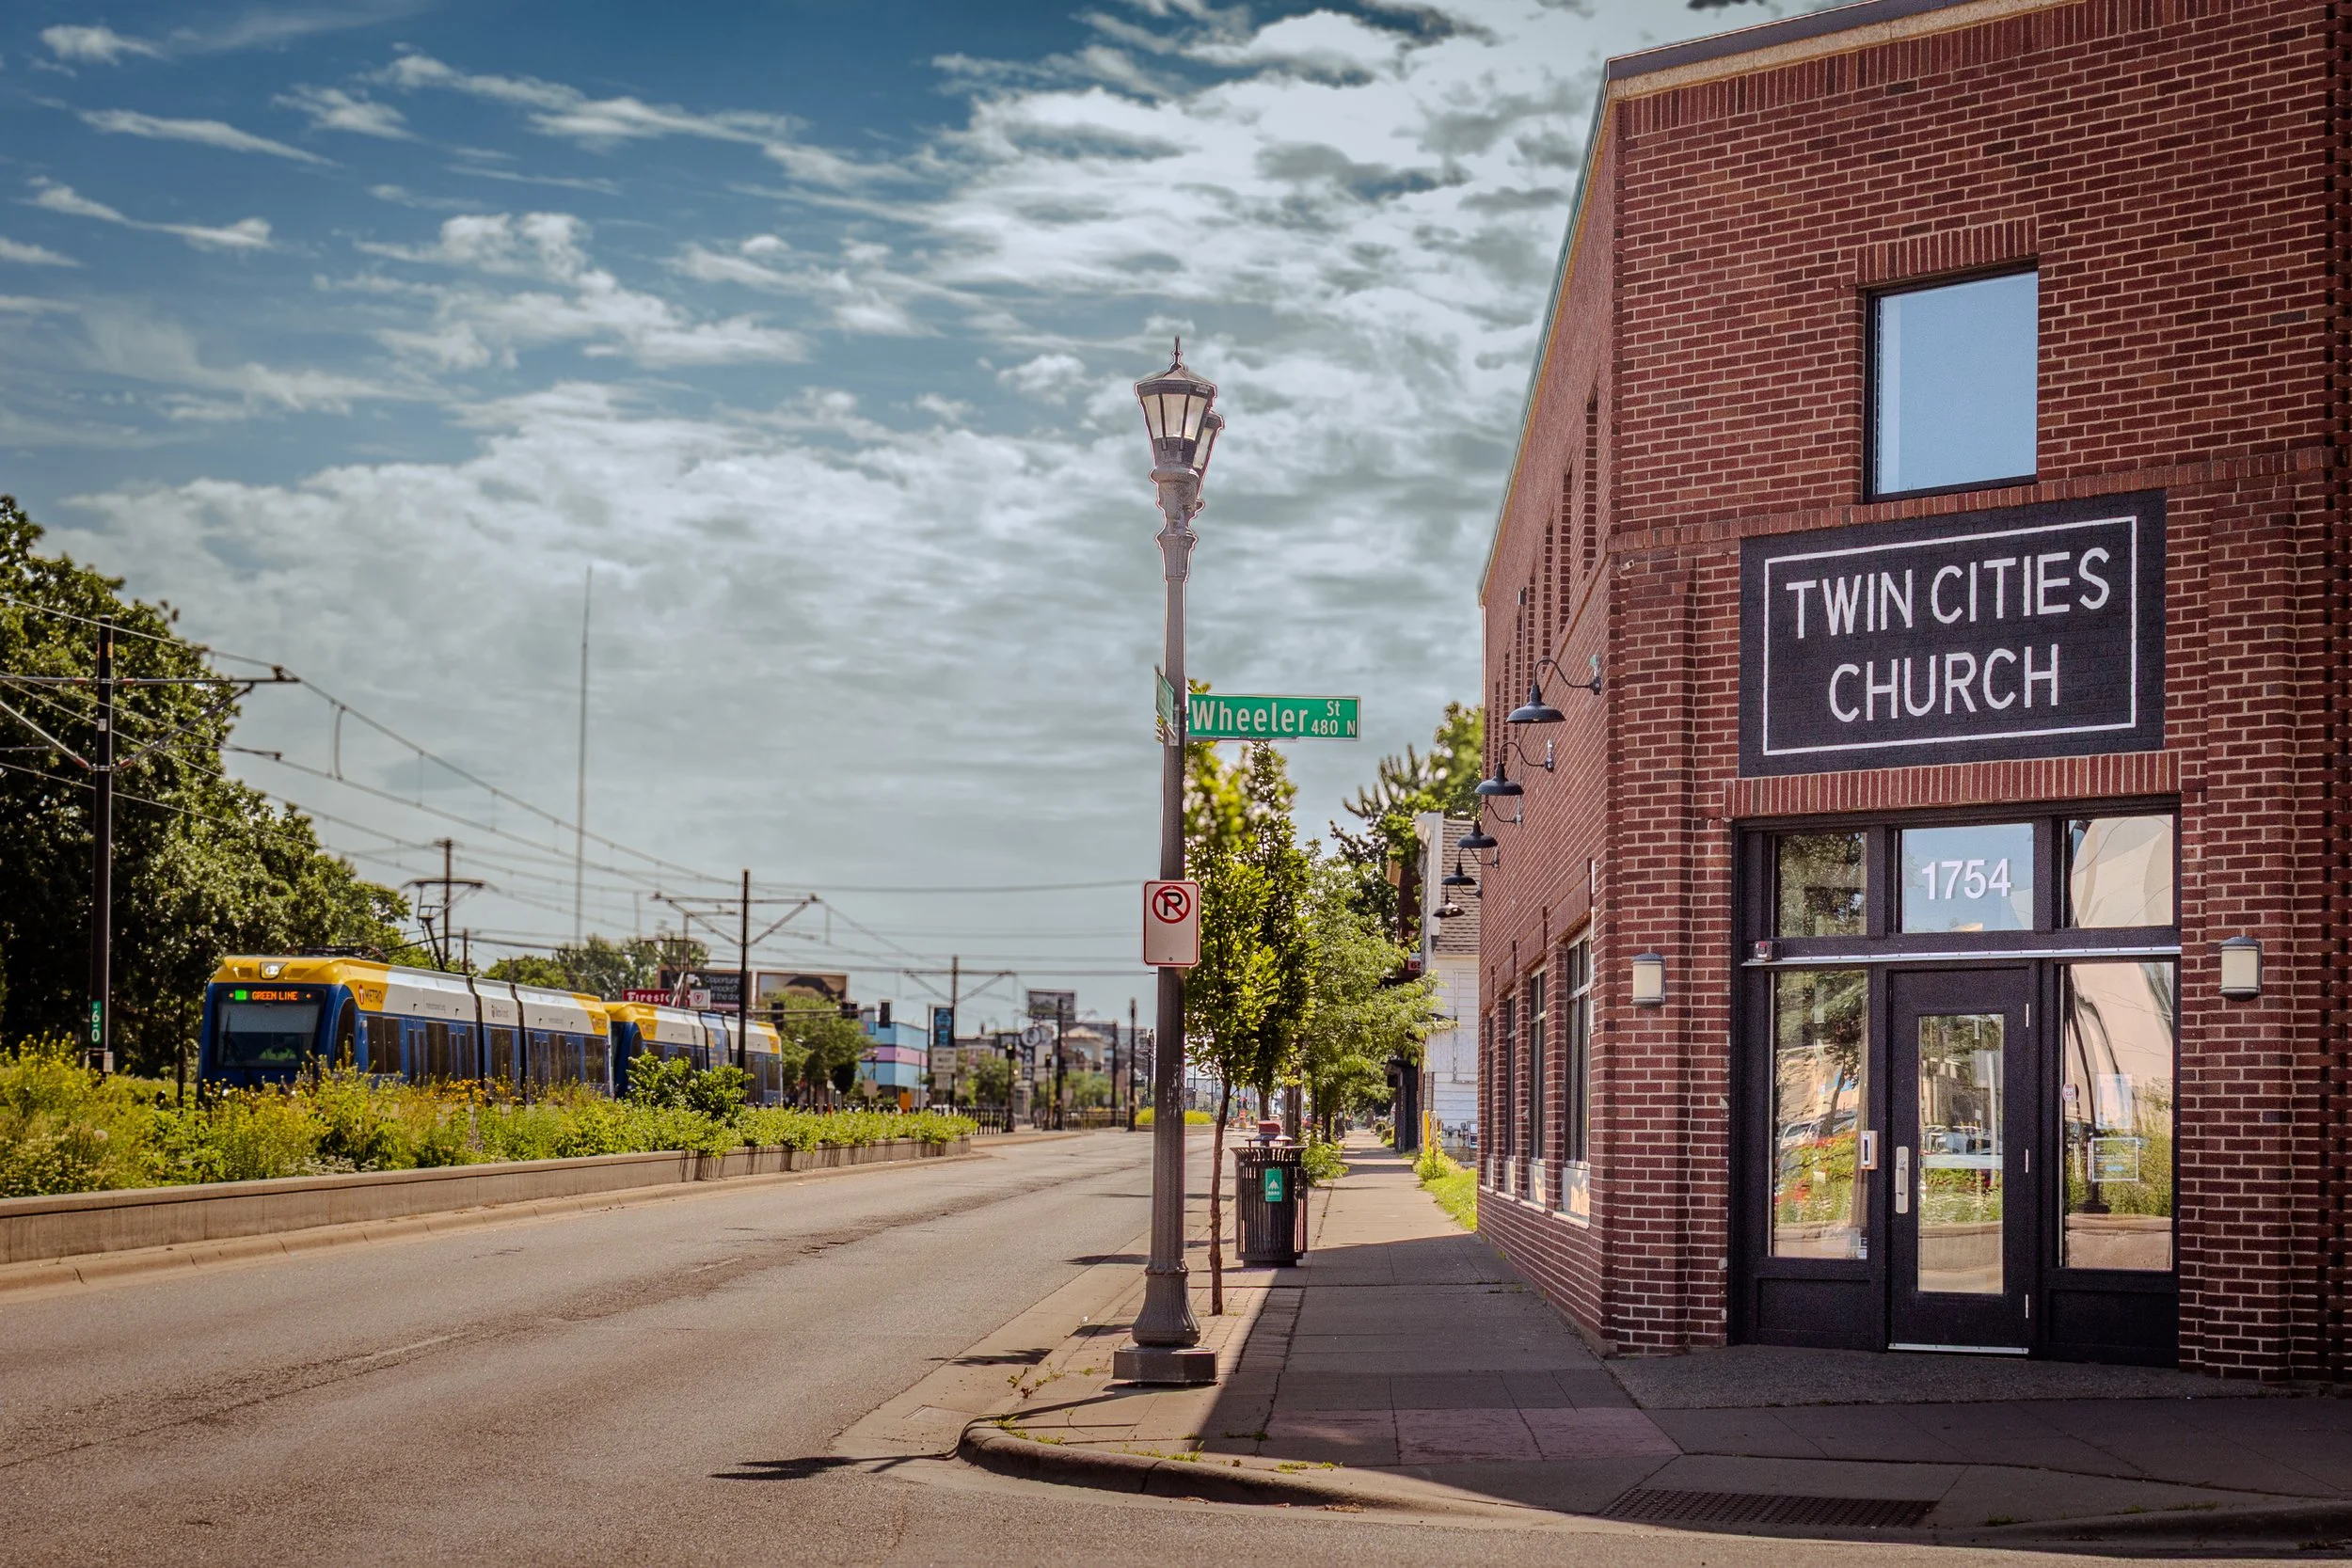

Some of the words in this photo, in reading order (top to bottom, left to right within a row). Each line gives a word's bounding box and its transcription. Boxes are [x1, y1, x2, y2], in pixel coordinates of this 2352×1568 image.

[1786, 568, 1914, 640] TWIN
[1931, 546, 2111, 625] CITIES
[1828, 643, 2058, 723] CHURCH
[1191, 700, 1309, 734] Wheeler
[1326, 700, 1341, 718] St
[1311, 719, 1339, 736] 480
[1346, 720, 1356, 736] N
[1921, 858, 2011, 900] 1754
[251, 990, 278, 1001] GREEN
[278, 990, 298, 1001] LINE
[627, 991, 670, 1004] Firest
